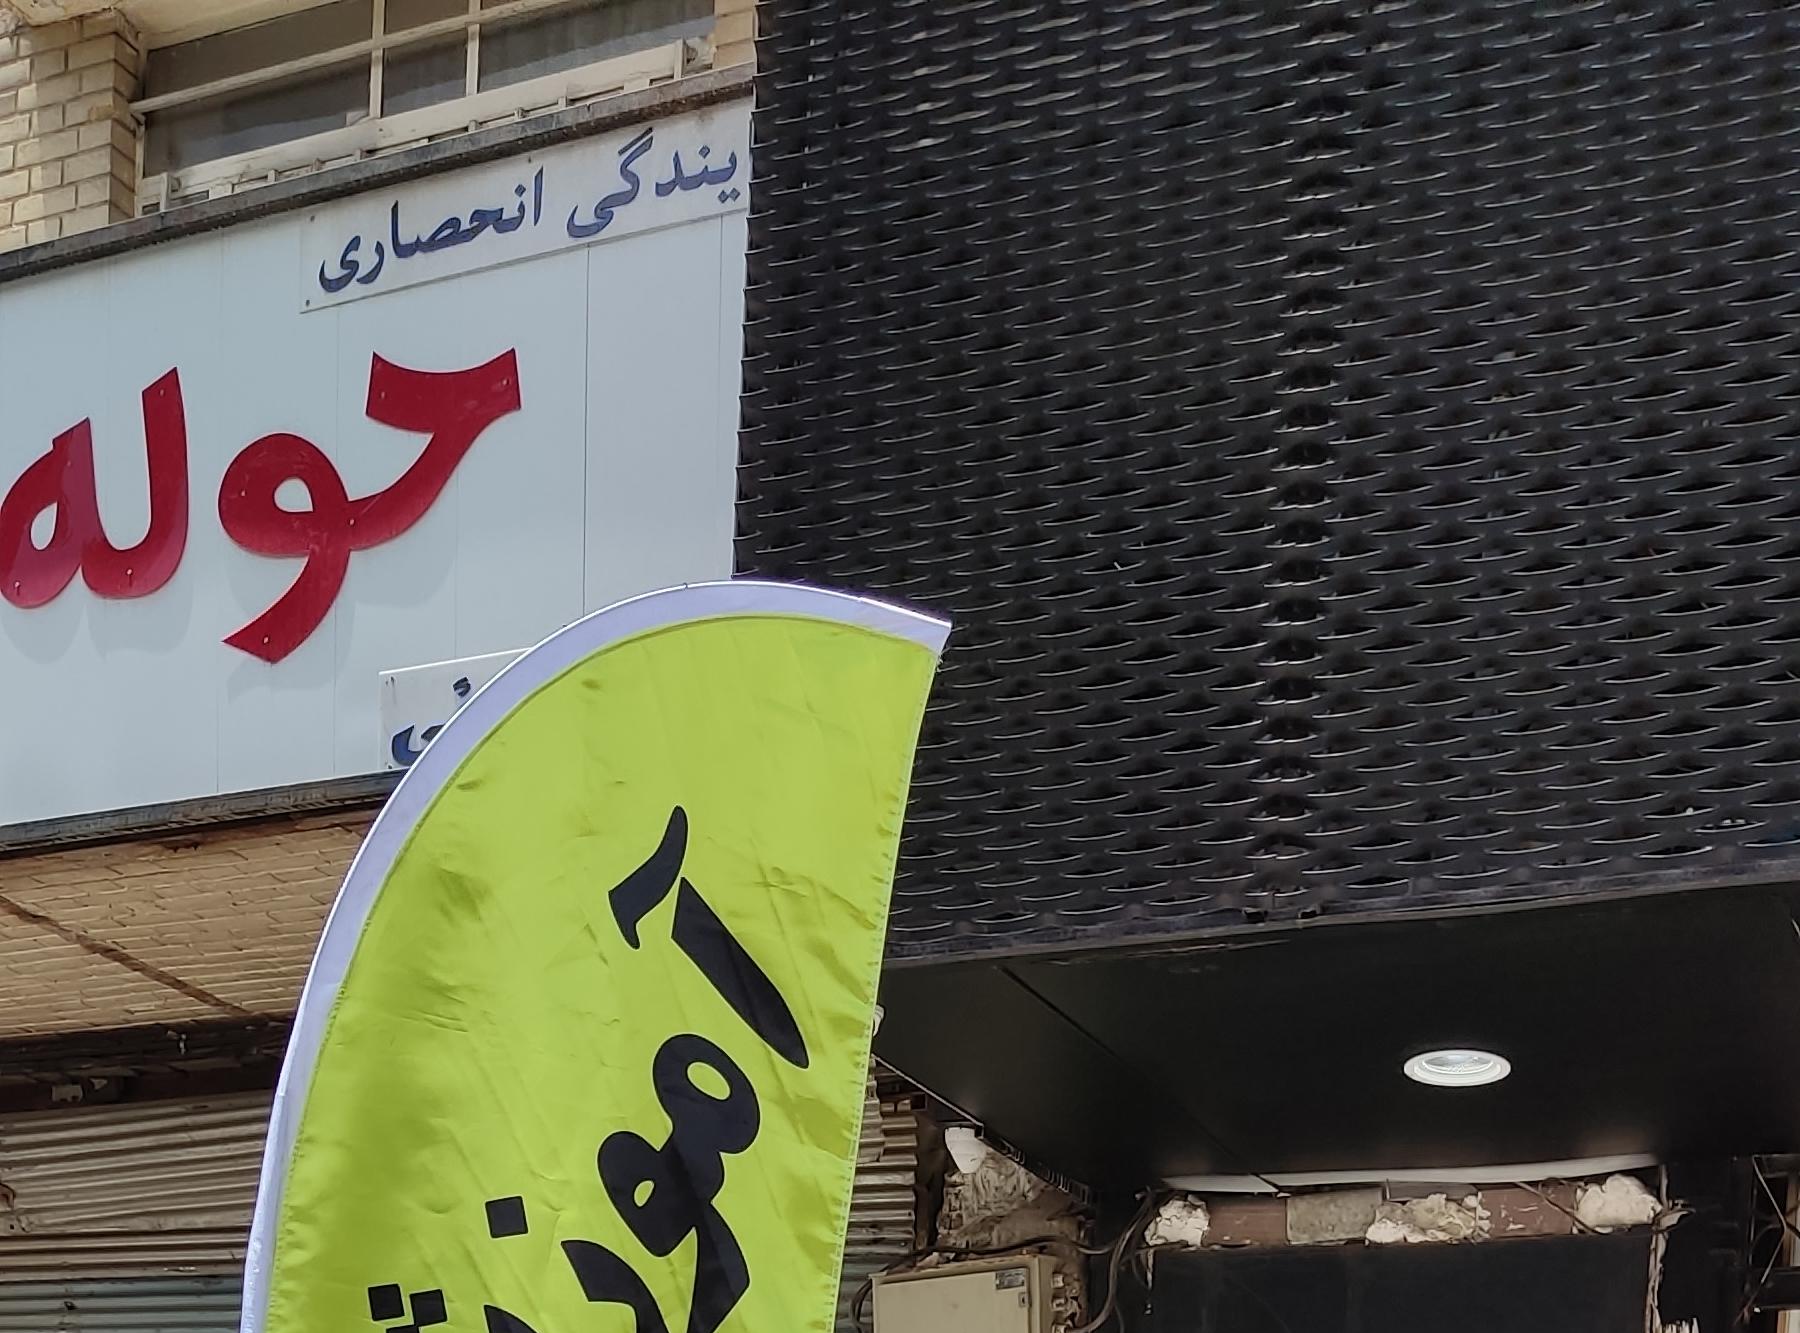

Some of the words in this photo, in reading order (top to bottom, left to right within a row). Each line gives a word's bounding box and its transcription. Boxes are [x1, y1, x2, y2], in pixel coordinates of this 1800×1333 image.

[318, 164, 544, 294] انحصاری
[567, 127, 741, 239] یندگی
[0, 347, 522, 664] حوله
